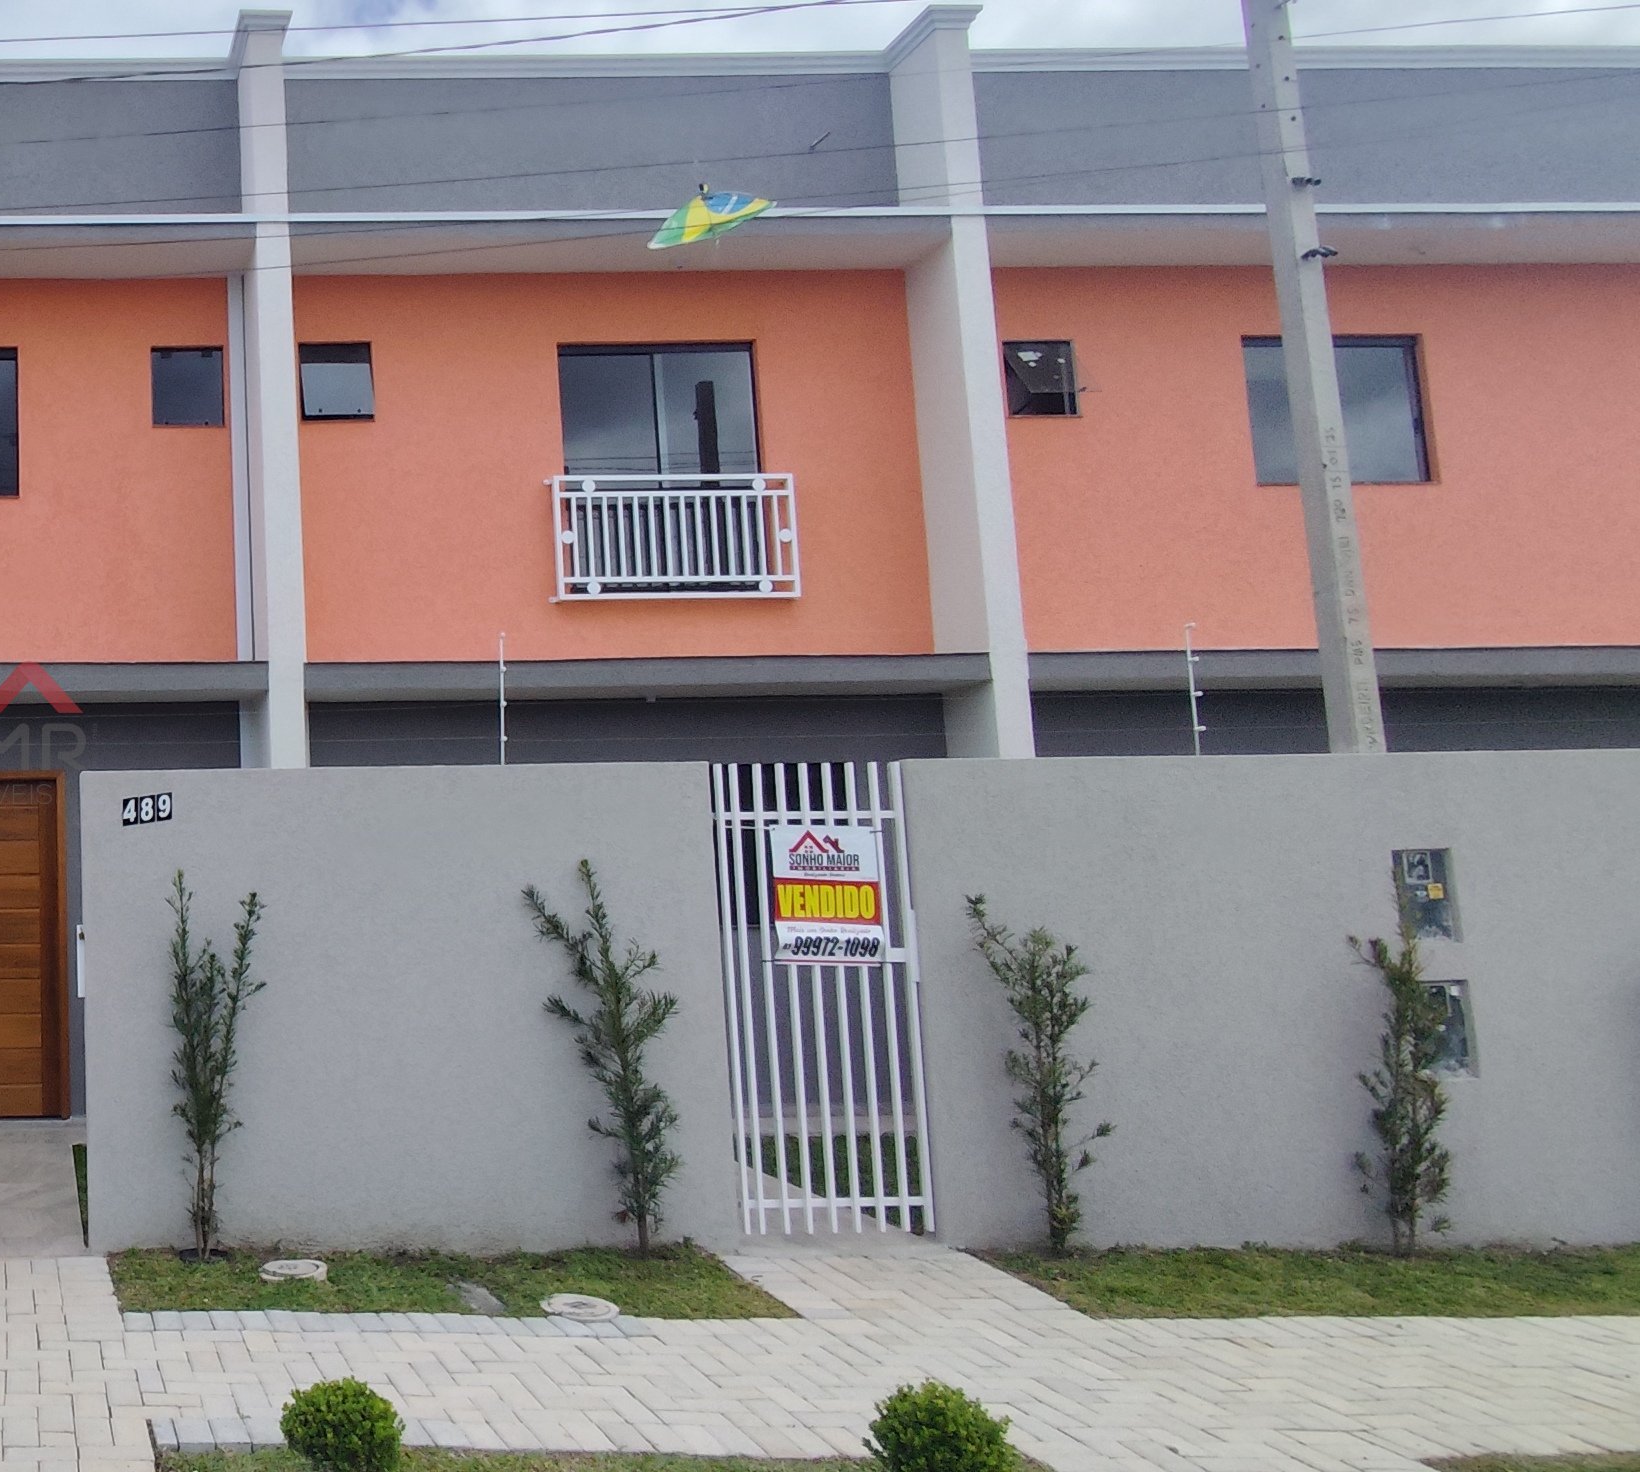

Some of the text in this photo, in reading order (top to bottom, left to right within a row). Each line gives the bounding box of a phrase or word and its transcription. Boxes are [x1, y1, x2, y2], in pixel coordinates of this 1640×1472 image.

[122, 793, 172, 824] 489
[789, 853, 860, 866] SONHO MAIOR
[777, 884, 876, 919] VENDIDO
[791, 936, 880, 957] 99972-1098
